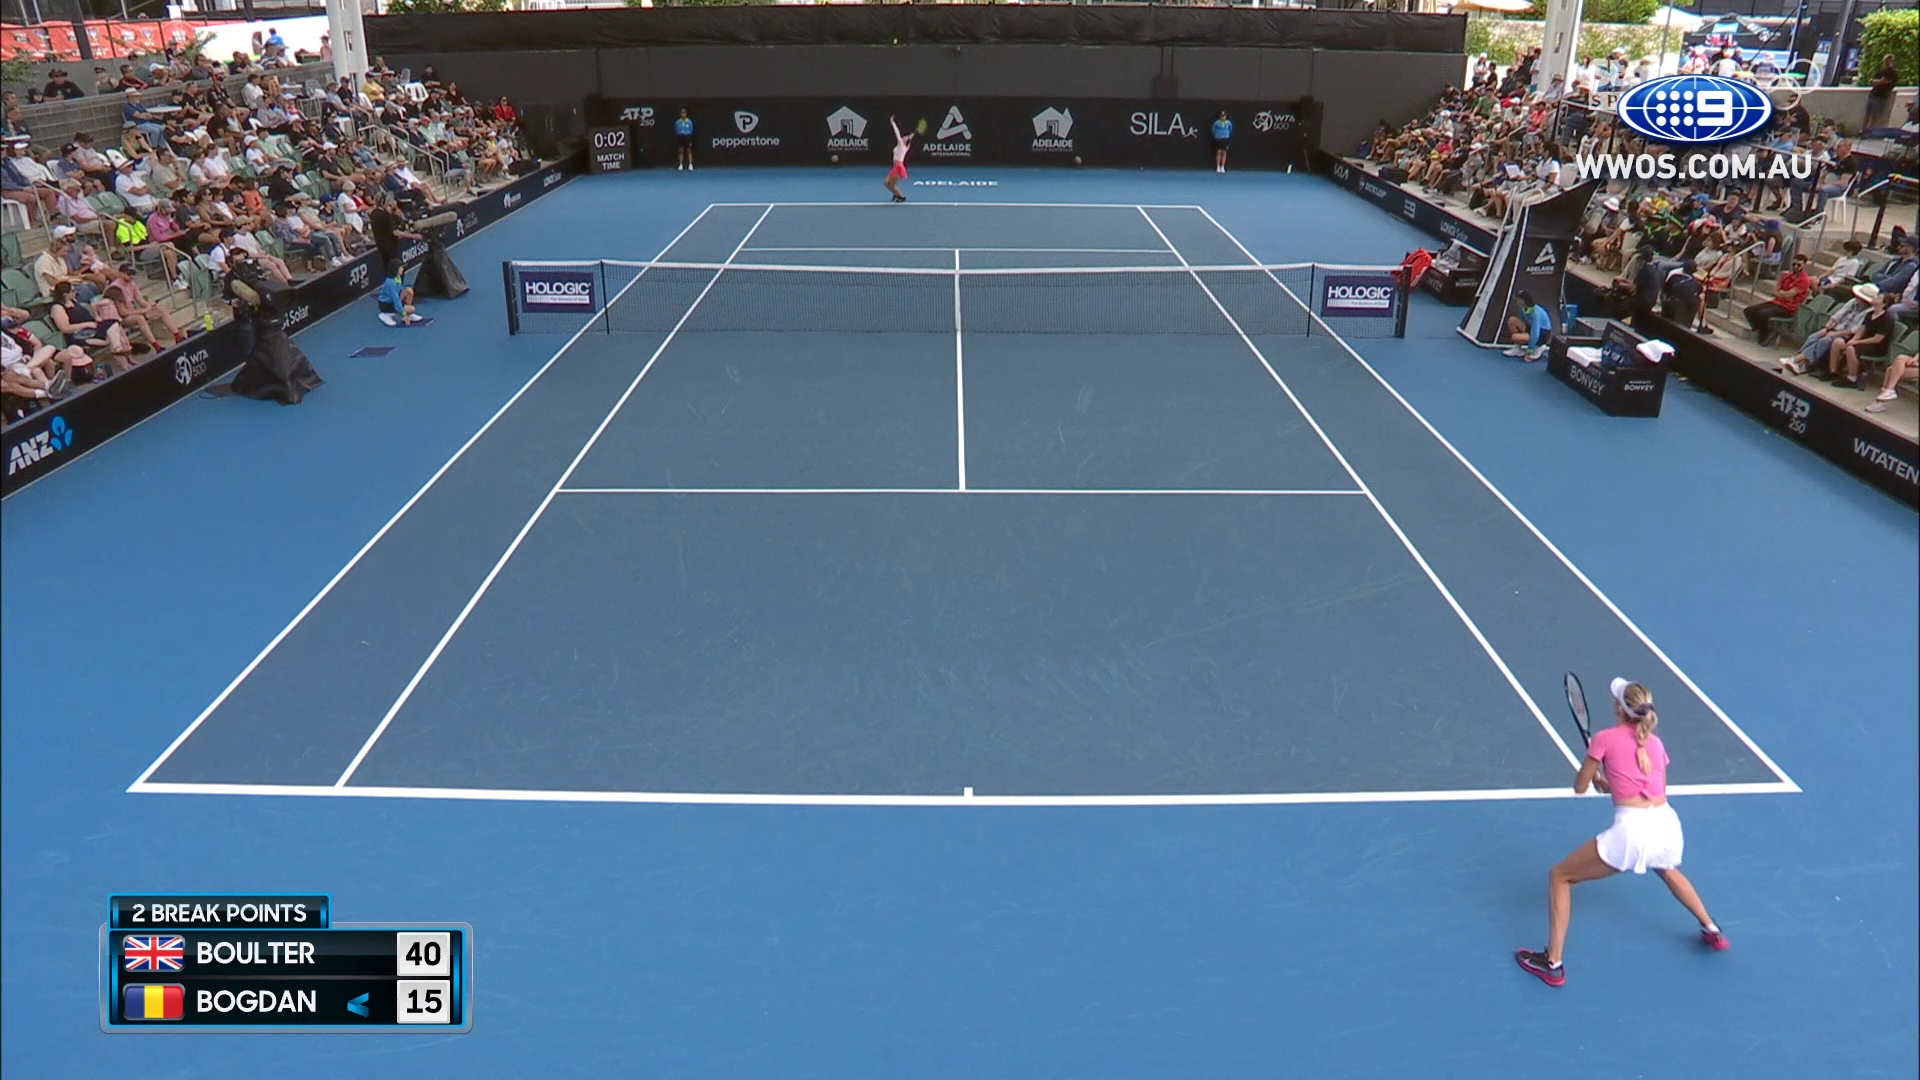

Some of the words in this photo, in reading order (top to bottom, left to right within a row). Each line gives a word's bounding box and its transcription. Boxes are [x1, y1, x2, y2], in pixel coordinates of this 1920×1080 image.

[620, 107, 654, 121] ATP
[1273, 114, 1296, 123] WTA
[640, 119, 655, 127] 250
[1129, 112, 1187, 137] SILA
[1273, 122, 1290, 130] 500
[594, 131, 626, 149] 0:02
[712, 136, 780, 148] pepperstone
[827, 138, 869, 147] ADELAIDE
[1032, 139, 1073, 148] ADELAIDE
[923, 143, 972, 152] ADELAIDE
[597, 153, 625, 163] MATCH
[602, 161, 621, 171] TIME
[349, 263, 368, 287] ATP
[525, 282, 590, 294] HOLOGIC
[1328, 286, 1391, 299] HOLOGIC
[290, 305, 309, 325] Solar
[189, 349, 209, 365] WTA
[193, 363, 207, 378] 500
[1570, 365, 1605, 396] BONVOY
[1624, 384, 1655, 392] BONVOY
[1771, 390, 1810, 419] ATP
[1788, 418, 1806, 434] 250
[8, 430, 54, 476] ANZ
[1854, 437, 1920, 488] WTATEN
